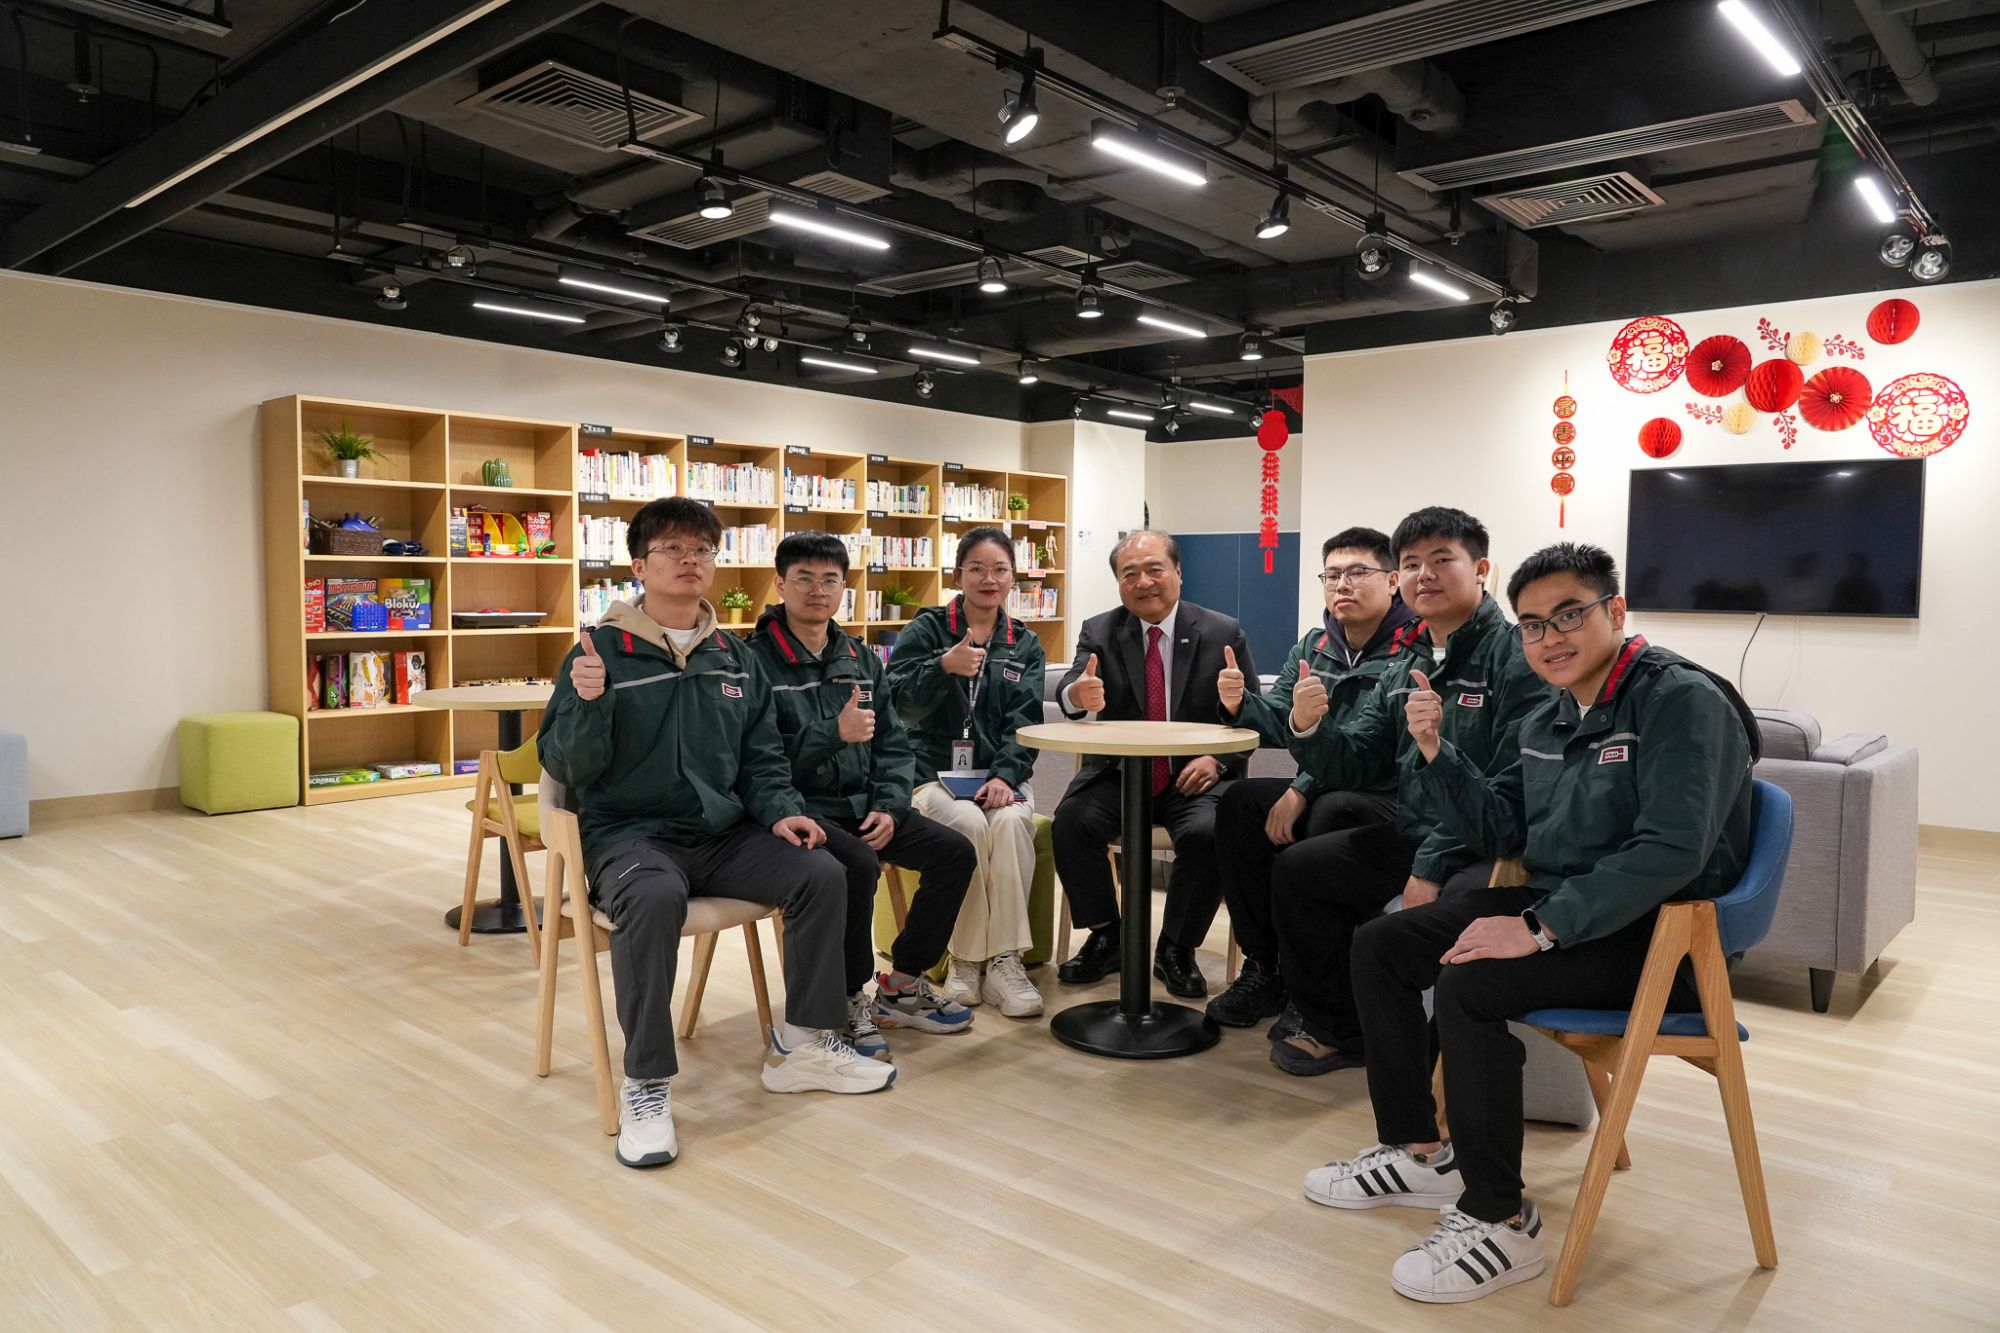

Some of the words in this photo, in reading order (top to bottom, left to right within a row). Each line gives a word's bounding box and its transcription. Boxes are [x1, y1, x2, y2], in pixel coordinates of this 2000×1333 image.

[1625, 335, 1669, 373] 福
[1889, 395, 1943, 435] 福
[327, 580, 377, 594] MASTERMIND
[384, 598, 421, 610] Blokus
